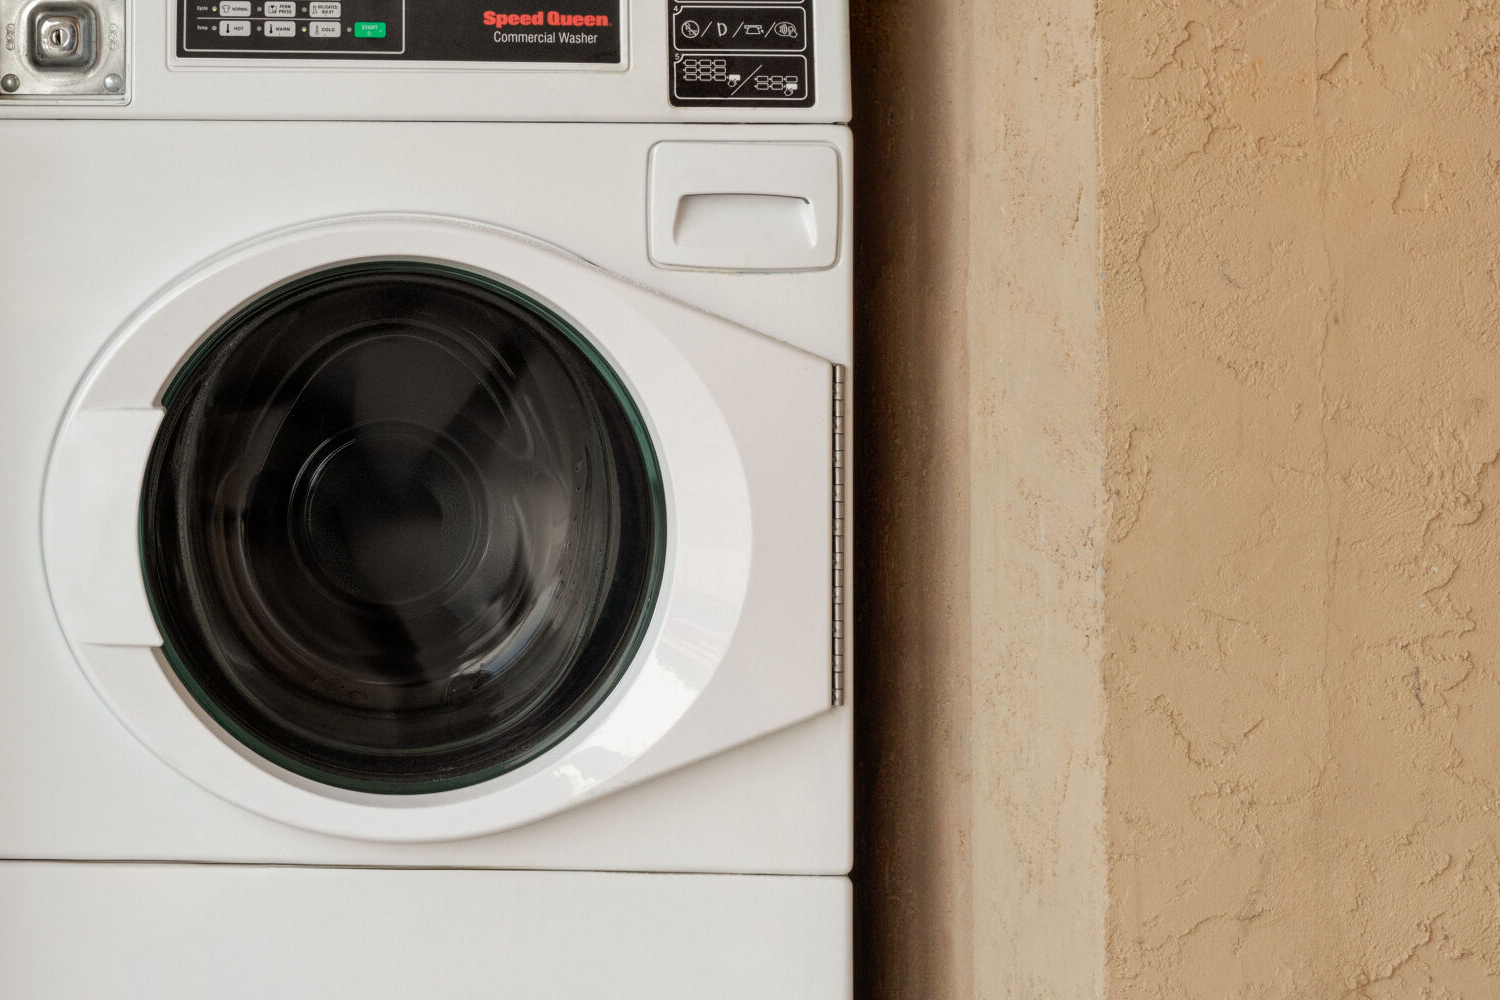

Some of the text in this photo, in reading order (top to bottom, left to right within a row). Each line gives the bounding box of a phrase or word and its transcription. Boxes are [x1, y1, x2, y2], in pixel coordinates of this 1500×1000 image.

[483, 10, 544, 28] Speed
[493, 31, 598, 44] Commercial Washer
